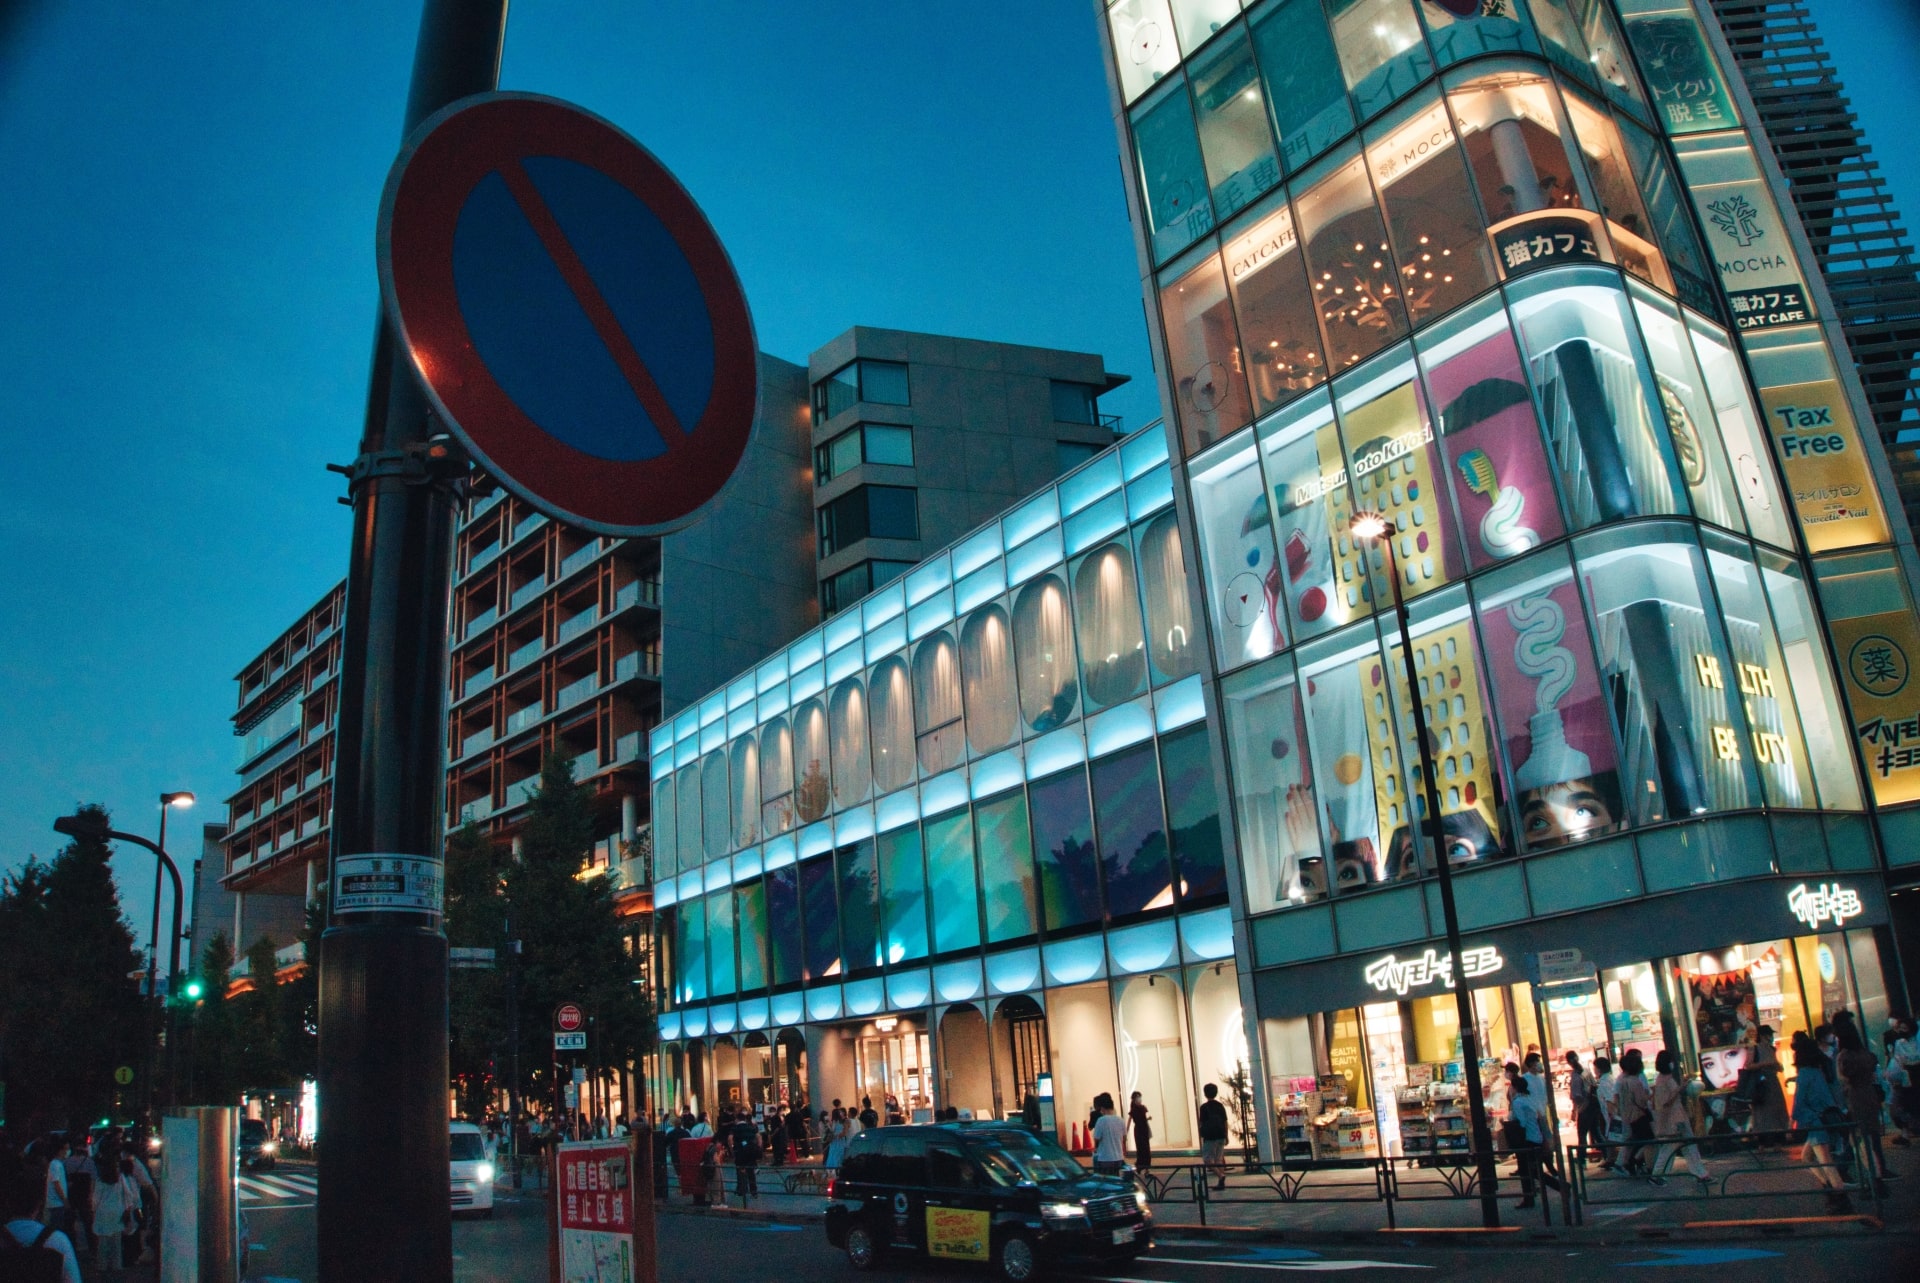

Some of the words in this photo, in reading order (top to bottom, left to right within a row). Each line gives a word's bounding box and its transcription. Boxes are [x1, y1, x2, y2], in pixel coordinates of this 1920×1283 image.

[1667, 99, 1722, 123] 脱毛
[1404, 117, 1468, 165] MOCHA
[1504, 233, 1597, 268] 猫カフェ
[1717, 255, 1787, 274] MOCHA
[1731, 292, 1799, 312] 猫カフェ
[1737, 315, 1766, 328] CAT
[1768, 310, 1805, 323] CAFE
[1775, 406, 1832, 429] Tax
[1780, 433, 1845, 458] Free
[1796, 485, 1861, 503] ネイルサロン
[1861, 647, 1899, 684] 薬
[1858, 712, 1920, 748] マツモ
